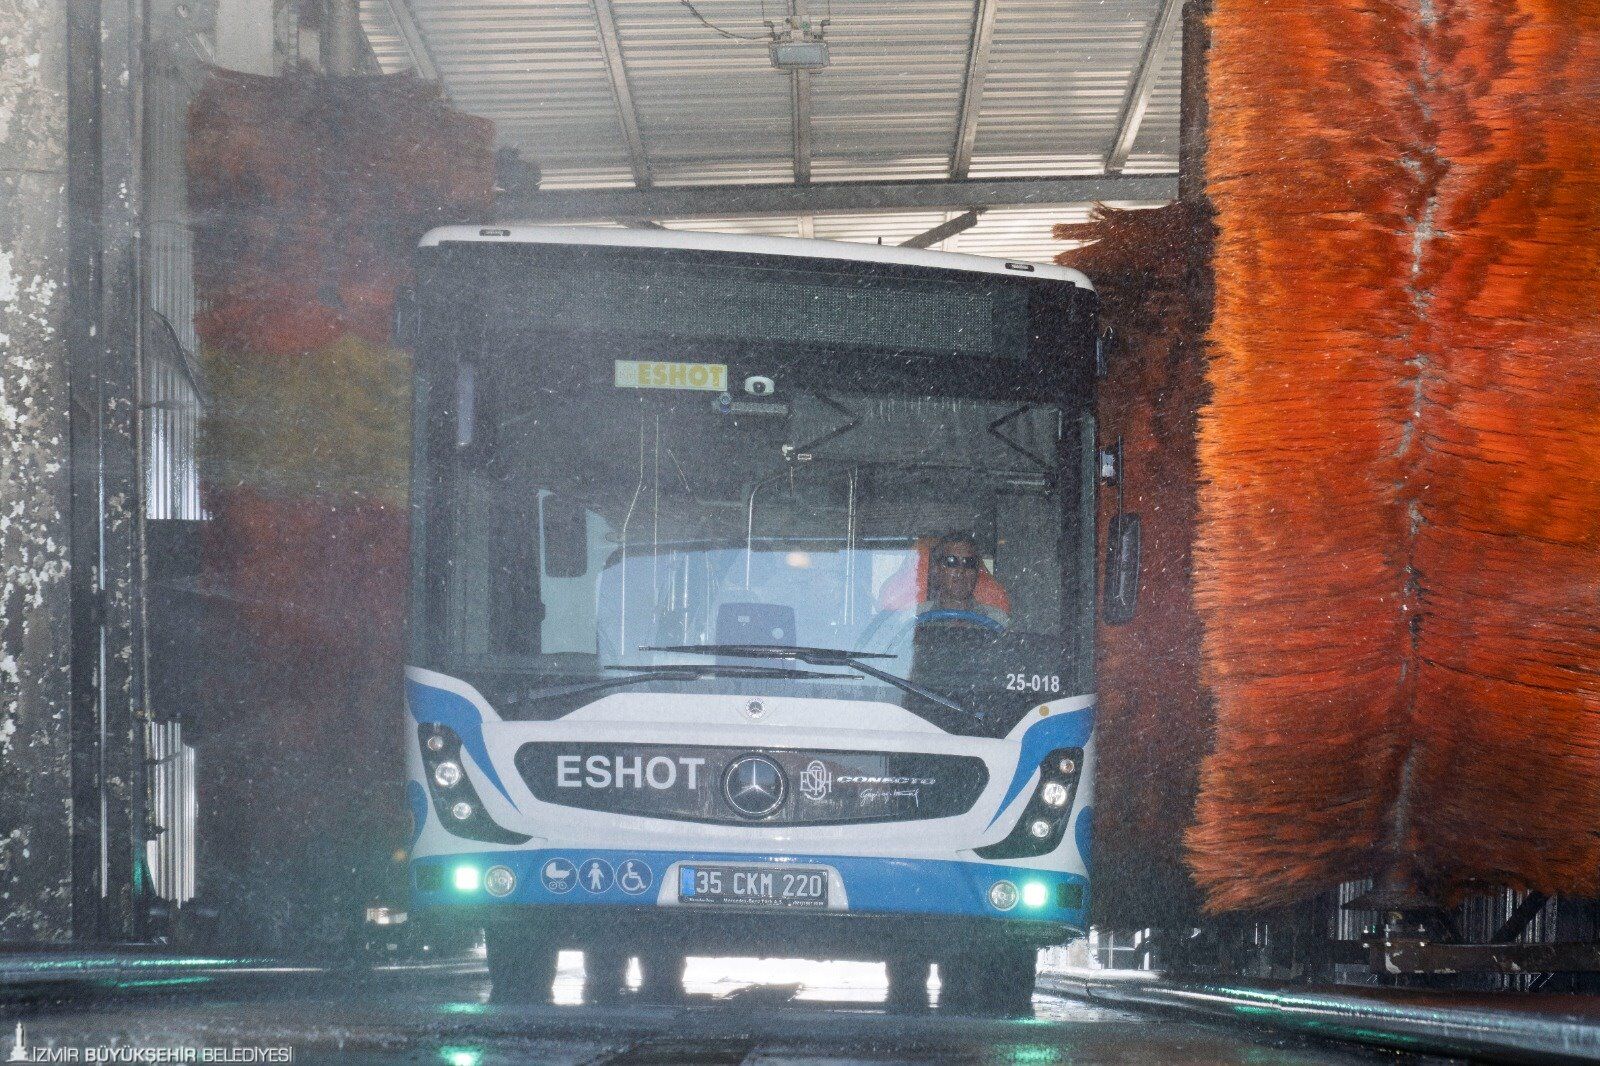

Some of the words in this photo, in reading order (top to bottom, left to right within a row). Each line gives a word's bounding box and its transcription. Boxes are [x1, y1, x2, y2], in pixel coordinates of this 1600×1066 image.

[638, 364, 724, 387] ESHOT
[1006, 674, 1060, 692] 25-018
[557, 755, 705, 790] ESHOT
[697, 871, 722, 894] 35
[733, 872, 772, 896] CKM
[782, 874, 822, 897] 220
